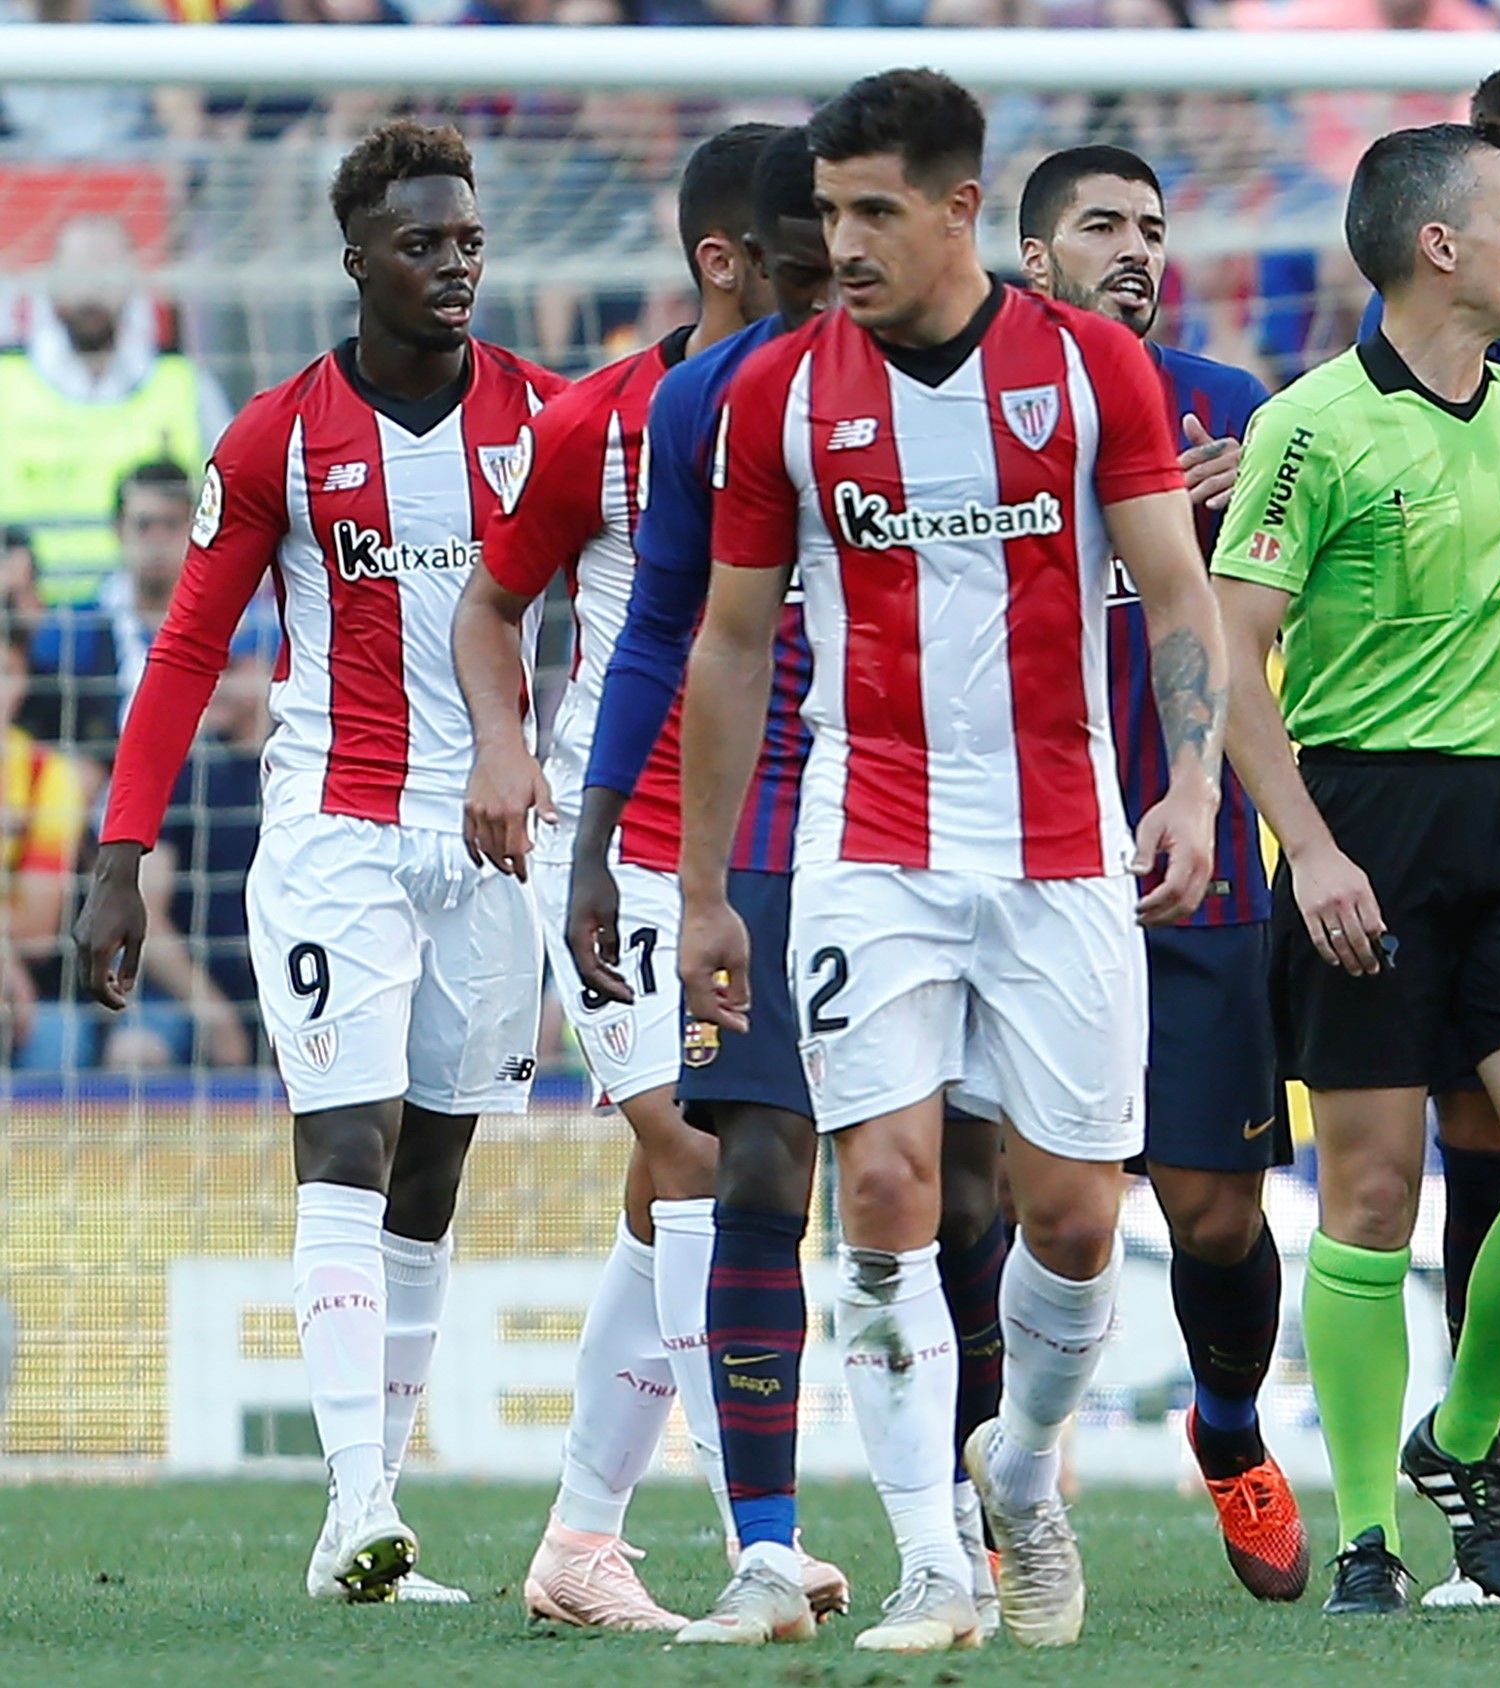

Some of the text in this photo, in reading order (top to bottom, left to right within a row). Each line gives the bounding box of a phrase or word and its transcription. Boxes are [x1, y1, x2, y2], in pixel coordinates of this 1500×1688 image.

[837, 482, 1061, 547] Kutxabank
[1263, 427, 1314, 526] WÜRTH
[287, 942, 331, 1021] 9
[803, 946, 849, 1036] 2
